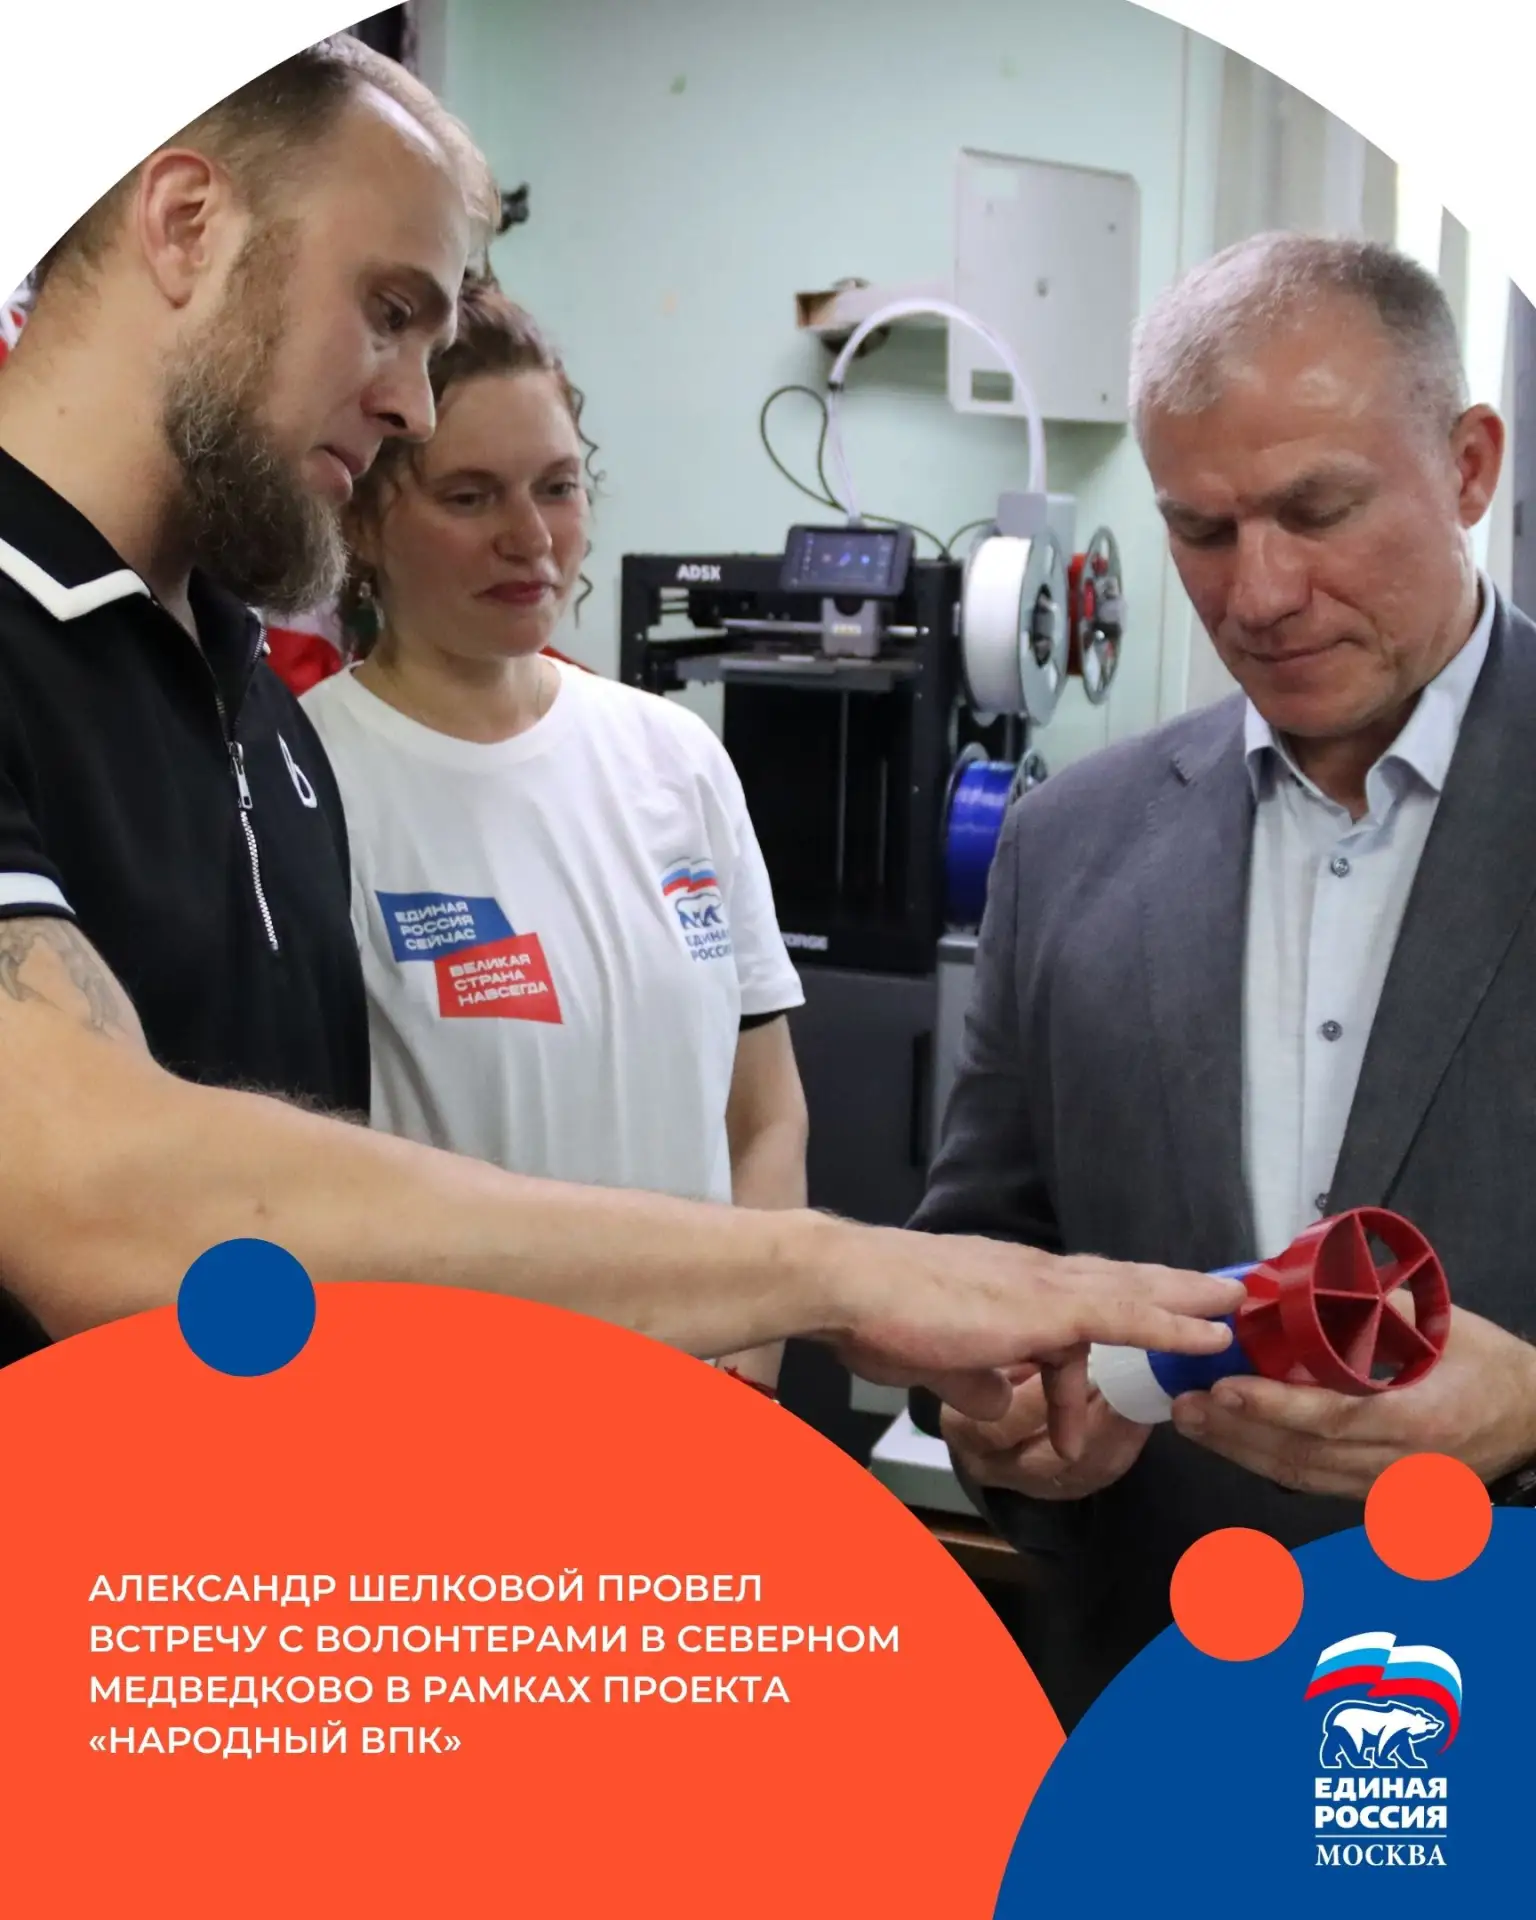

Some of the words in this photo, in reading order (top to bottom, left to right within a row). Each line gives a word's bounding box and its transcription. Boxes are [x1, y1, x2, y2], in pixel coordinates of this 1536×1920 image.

[394, 901, 469, 923] ЕДИНАЯ
[400, 914, 475, 936] РОССИЯ
[405, 928, 477, 950] СЕЙЧАС
[449, 953, 531, 977] ВЕЛИКАЯ
[454, 969, 526, 991] СТРАНА
[458, 980, 549, 1006] НАВСЕГДА
